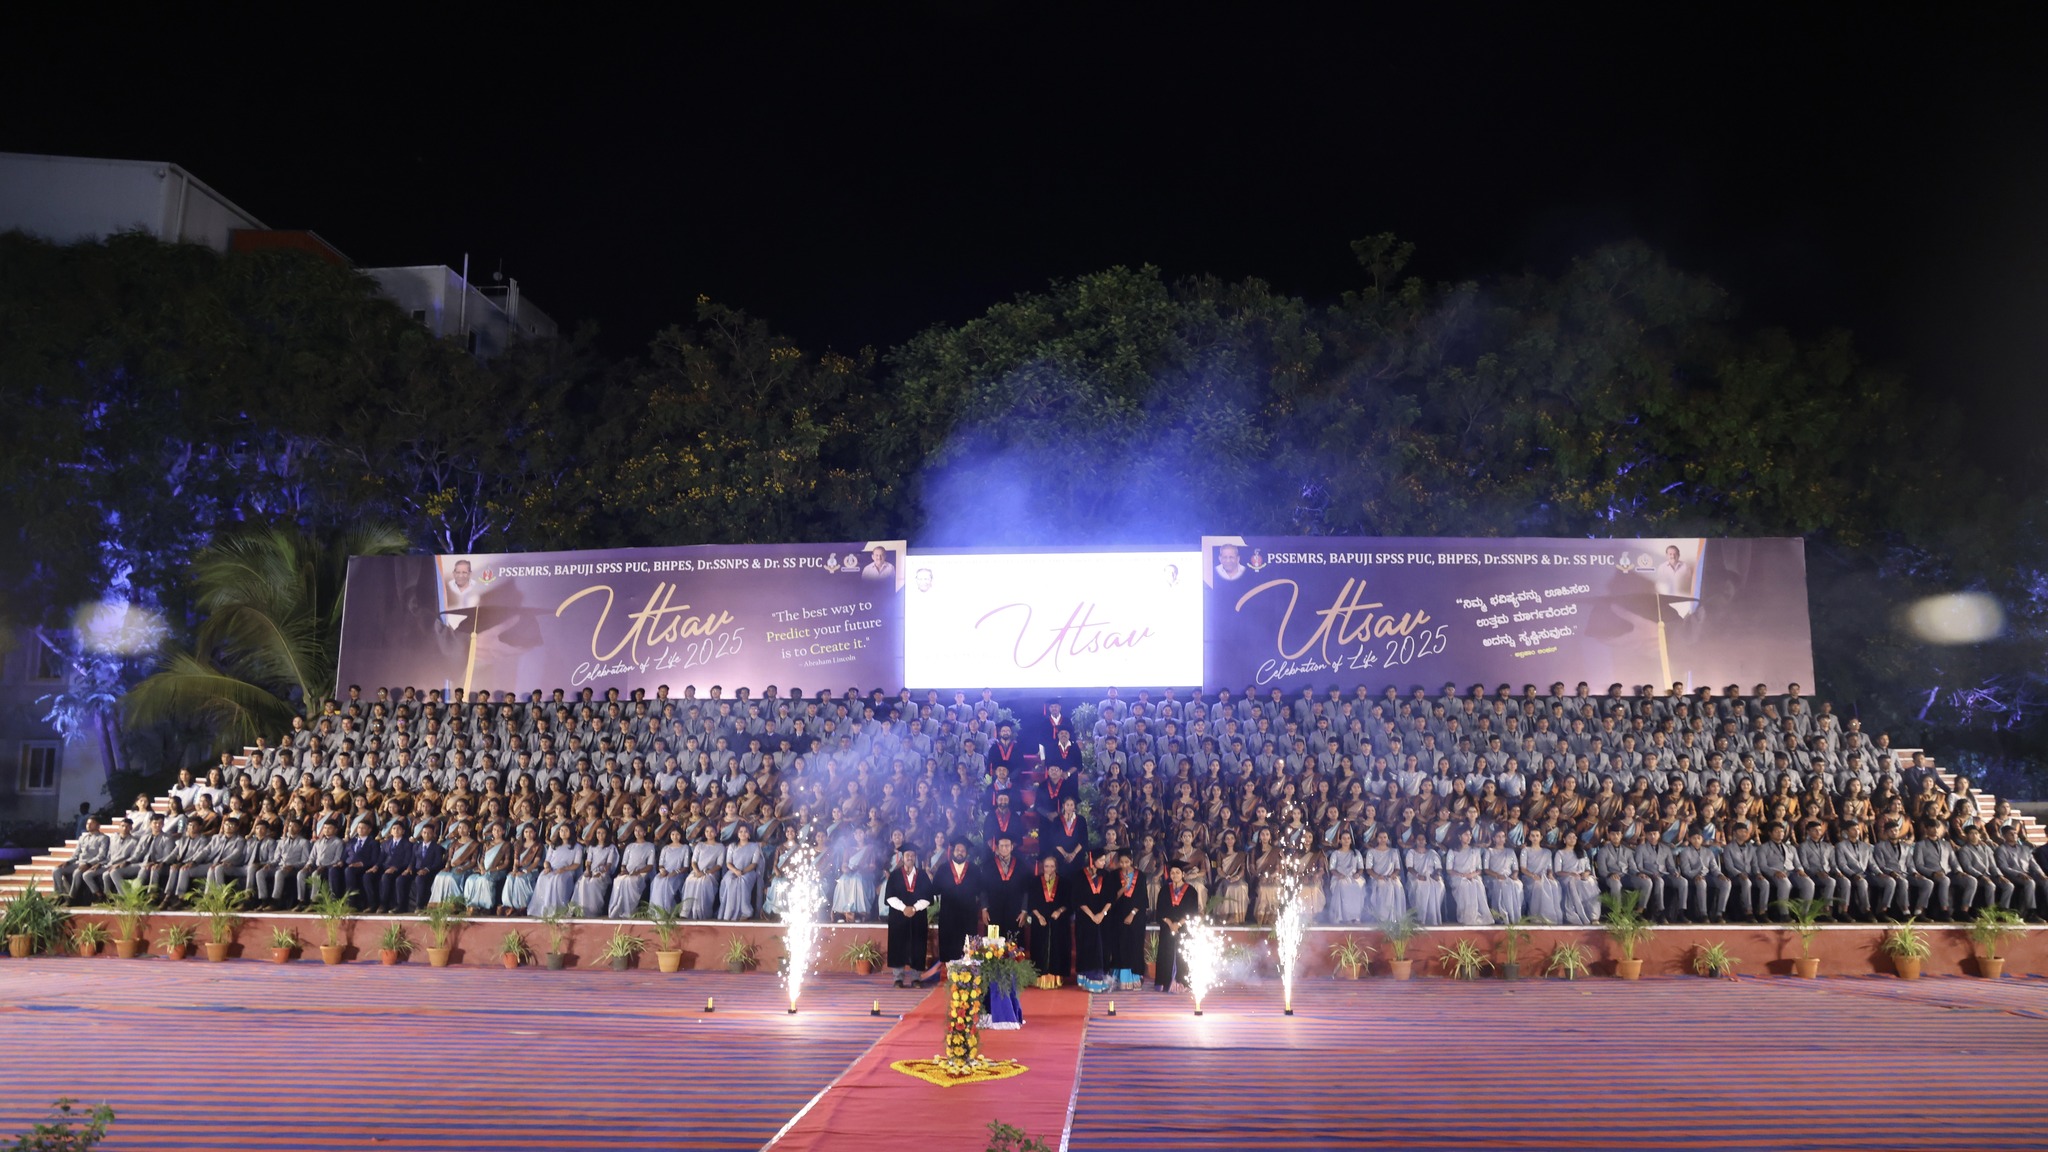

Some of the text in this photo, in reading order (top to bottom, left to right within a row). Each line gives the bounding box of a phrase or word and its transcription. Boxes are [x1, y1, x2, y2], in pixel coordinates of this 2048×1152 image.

[499, 557, 823, 577] PSSEMRS, BAPUJI SPSS PUC, BHPES, Dr.SSNPS & Dr. SS PUC
[1267, 553, 1615, 566] PSSEMRS, BAPUJI SPSS PUC, BHPES, Dr.SSNPS & Dr. SS PUC
[1489, 588, 1543, 608] ಭವಿಷ್ಯವನ್ನು
[1544, 583, 1591, 598] ಊಹಿಸಲು
[802, 606, 828, 620] best
[830, 603, 856, 616] way
[858, 601, 873, 612] to
[1235, 577, 1431, 666] Utsav
[1476, 604, 1578, 630] ಉತ್ತಮ ಮಾರ್ಗವೆಂದರೆ
[555, 581, 735, 666] Utsav
[766, 617, 883, 643] Predict your future
[974, 601, 1156, 673] Utsav
[1482, 633, 1517, 648] ಅದನ್ನು
[571, 627, 745, 687] Celebration of Life 2025
[781, 647, 792, 660] is
[794, 647, 808, 658] to
[810, 640, 851, 656] Create
[804, 658, 832, 668] Abraham
[833, 654, 857, 664] Lincoln
[1255, 624, 1449, 686] Celebration of Life 2025
